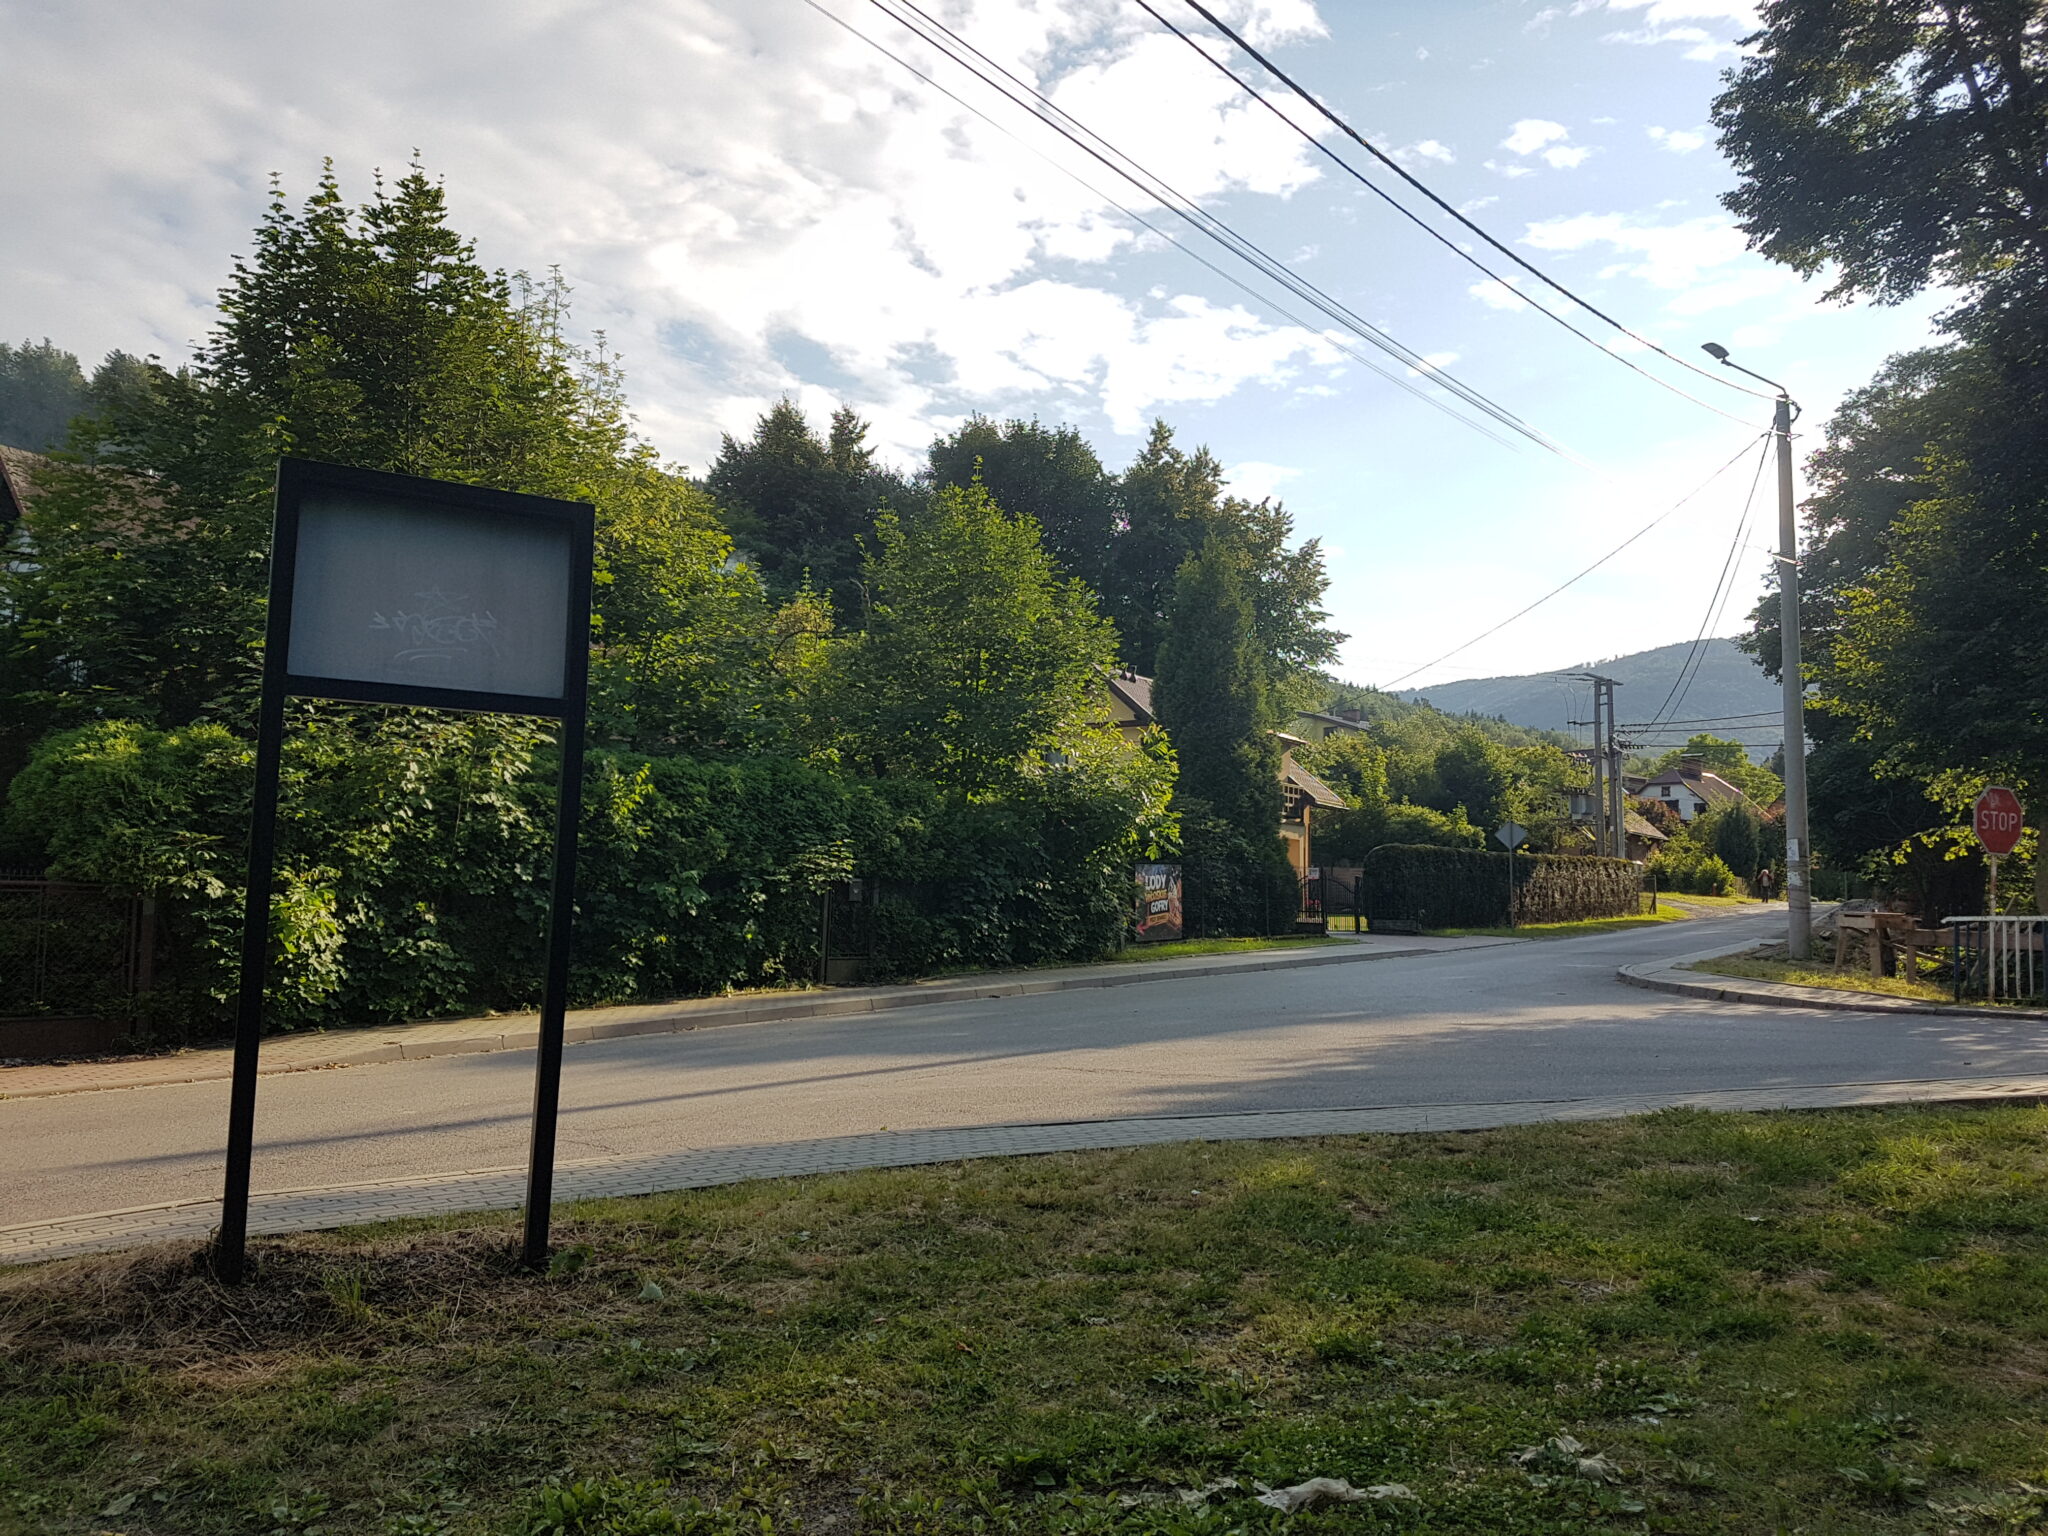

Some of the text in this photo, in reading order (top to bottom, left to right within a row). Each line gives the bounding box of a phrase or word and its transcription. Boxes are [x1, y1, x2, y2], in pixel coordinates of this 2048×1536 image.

[1981, 810, 2018, 833] STOP
[1145, 874, 1167, 891] LODY
[1151, 899, 1169, 914] GOFRY
